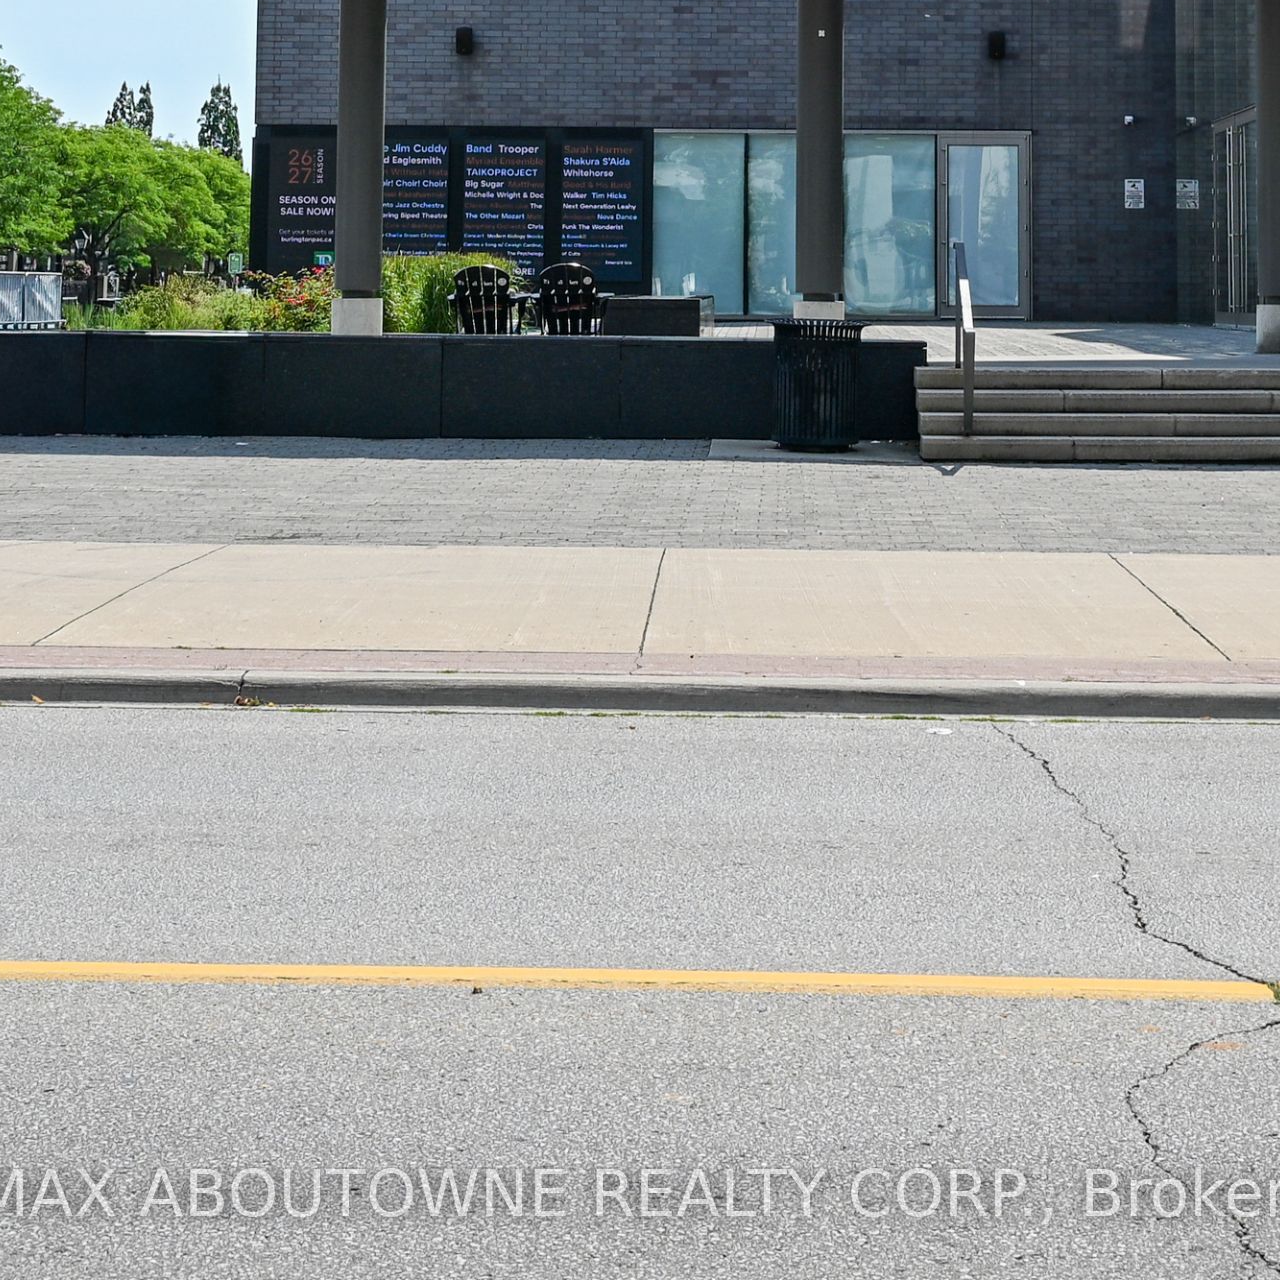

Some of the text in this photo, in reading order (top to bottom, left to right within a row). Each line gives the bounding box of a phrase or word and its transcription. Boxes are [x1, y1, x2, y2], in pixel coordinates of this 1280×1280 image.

[392, 144, 410, 153] Jim
[413, 144, 448, 158] Cuddy
[466, 144, 539, 156] Band Trooper
[563, 145, 633, 154] Sarah Harmer
[288, 149, 313, 166] 26
[392, 156, 442, 166] Eaglesmith
[563, 157, 600, 166] Shakura
[316, 148, 324, 184] SEASON
[288, 167, 313, 184] 27
[466, 168, 538, 177] TAIKOPROJECT
[563, 169, 614, 178] Whitehorse
[383, 179, 448, 188] oir! Choir! Choir!
[464, 180, 478, 189] Big
[480, 180, 504, 189] Sugar
[279, 195, 336, 204] SEASON ON
[464, 191, 494, 199] Michelle
[496, 191, 521, 200] Wright
[529, 191, 544, 199] Doc
[563, 192, 627, 200] Walker Tim Hicks
[280, 207, 334, 216] SALE NOW!
[617, 203, 637, 211] Leahy
[400, 212, 420, 220] Biped
[479, 212, 499, 220] Other
[501, 212, 525, 220] Mozart
[616, 213, 638, 221] Dance
[513, 267, 535, 276] ORE!
